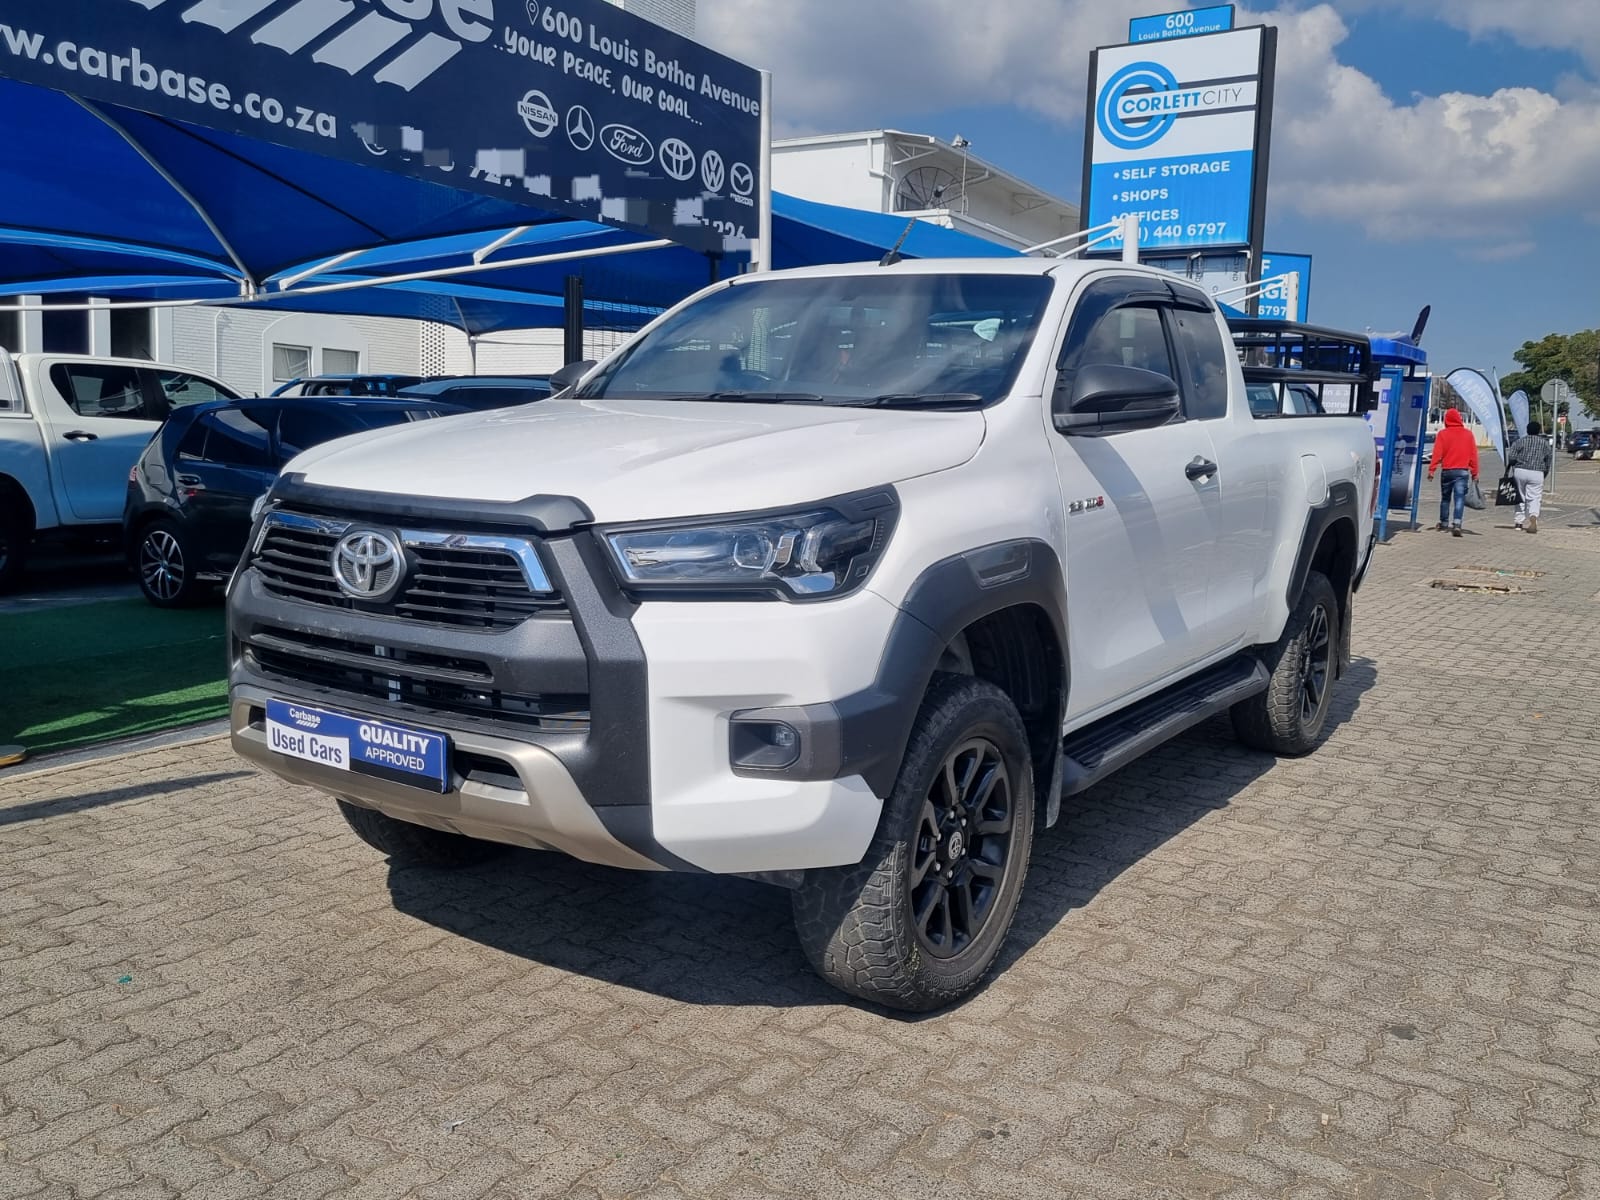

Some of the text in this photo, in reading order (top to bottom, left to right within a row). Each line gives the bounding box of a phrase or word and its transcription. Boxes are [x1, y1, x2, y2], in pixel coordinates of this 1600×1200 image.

[1138, 13, 1221, 41] 600 Louis Botha Avenue
[541, 6, 760, 117] 600 Louis Botha Avenue
[621, 74, 654, 105] OUR
[519, 103, 557, 123] NISSAN
[609, 129, 645, 159] Ford
[1122, 160, 1231, 180] SELF STORAGE
[1120, 188, 1169, 202] SHOPS
[1153, 225, 1182, 238] 440
[1186, 222, 1227, 237] 6797
[289, 707, 321, 724] Carbase
[271, 727, 342, 764] Used Cars
[359, 724, 430, 755] QUALITY
[365, 746, 425, 771] APPROVED
